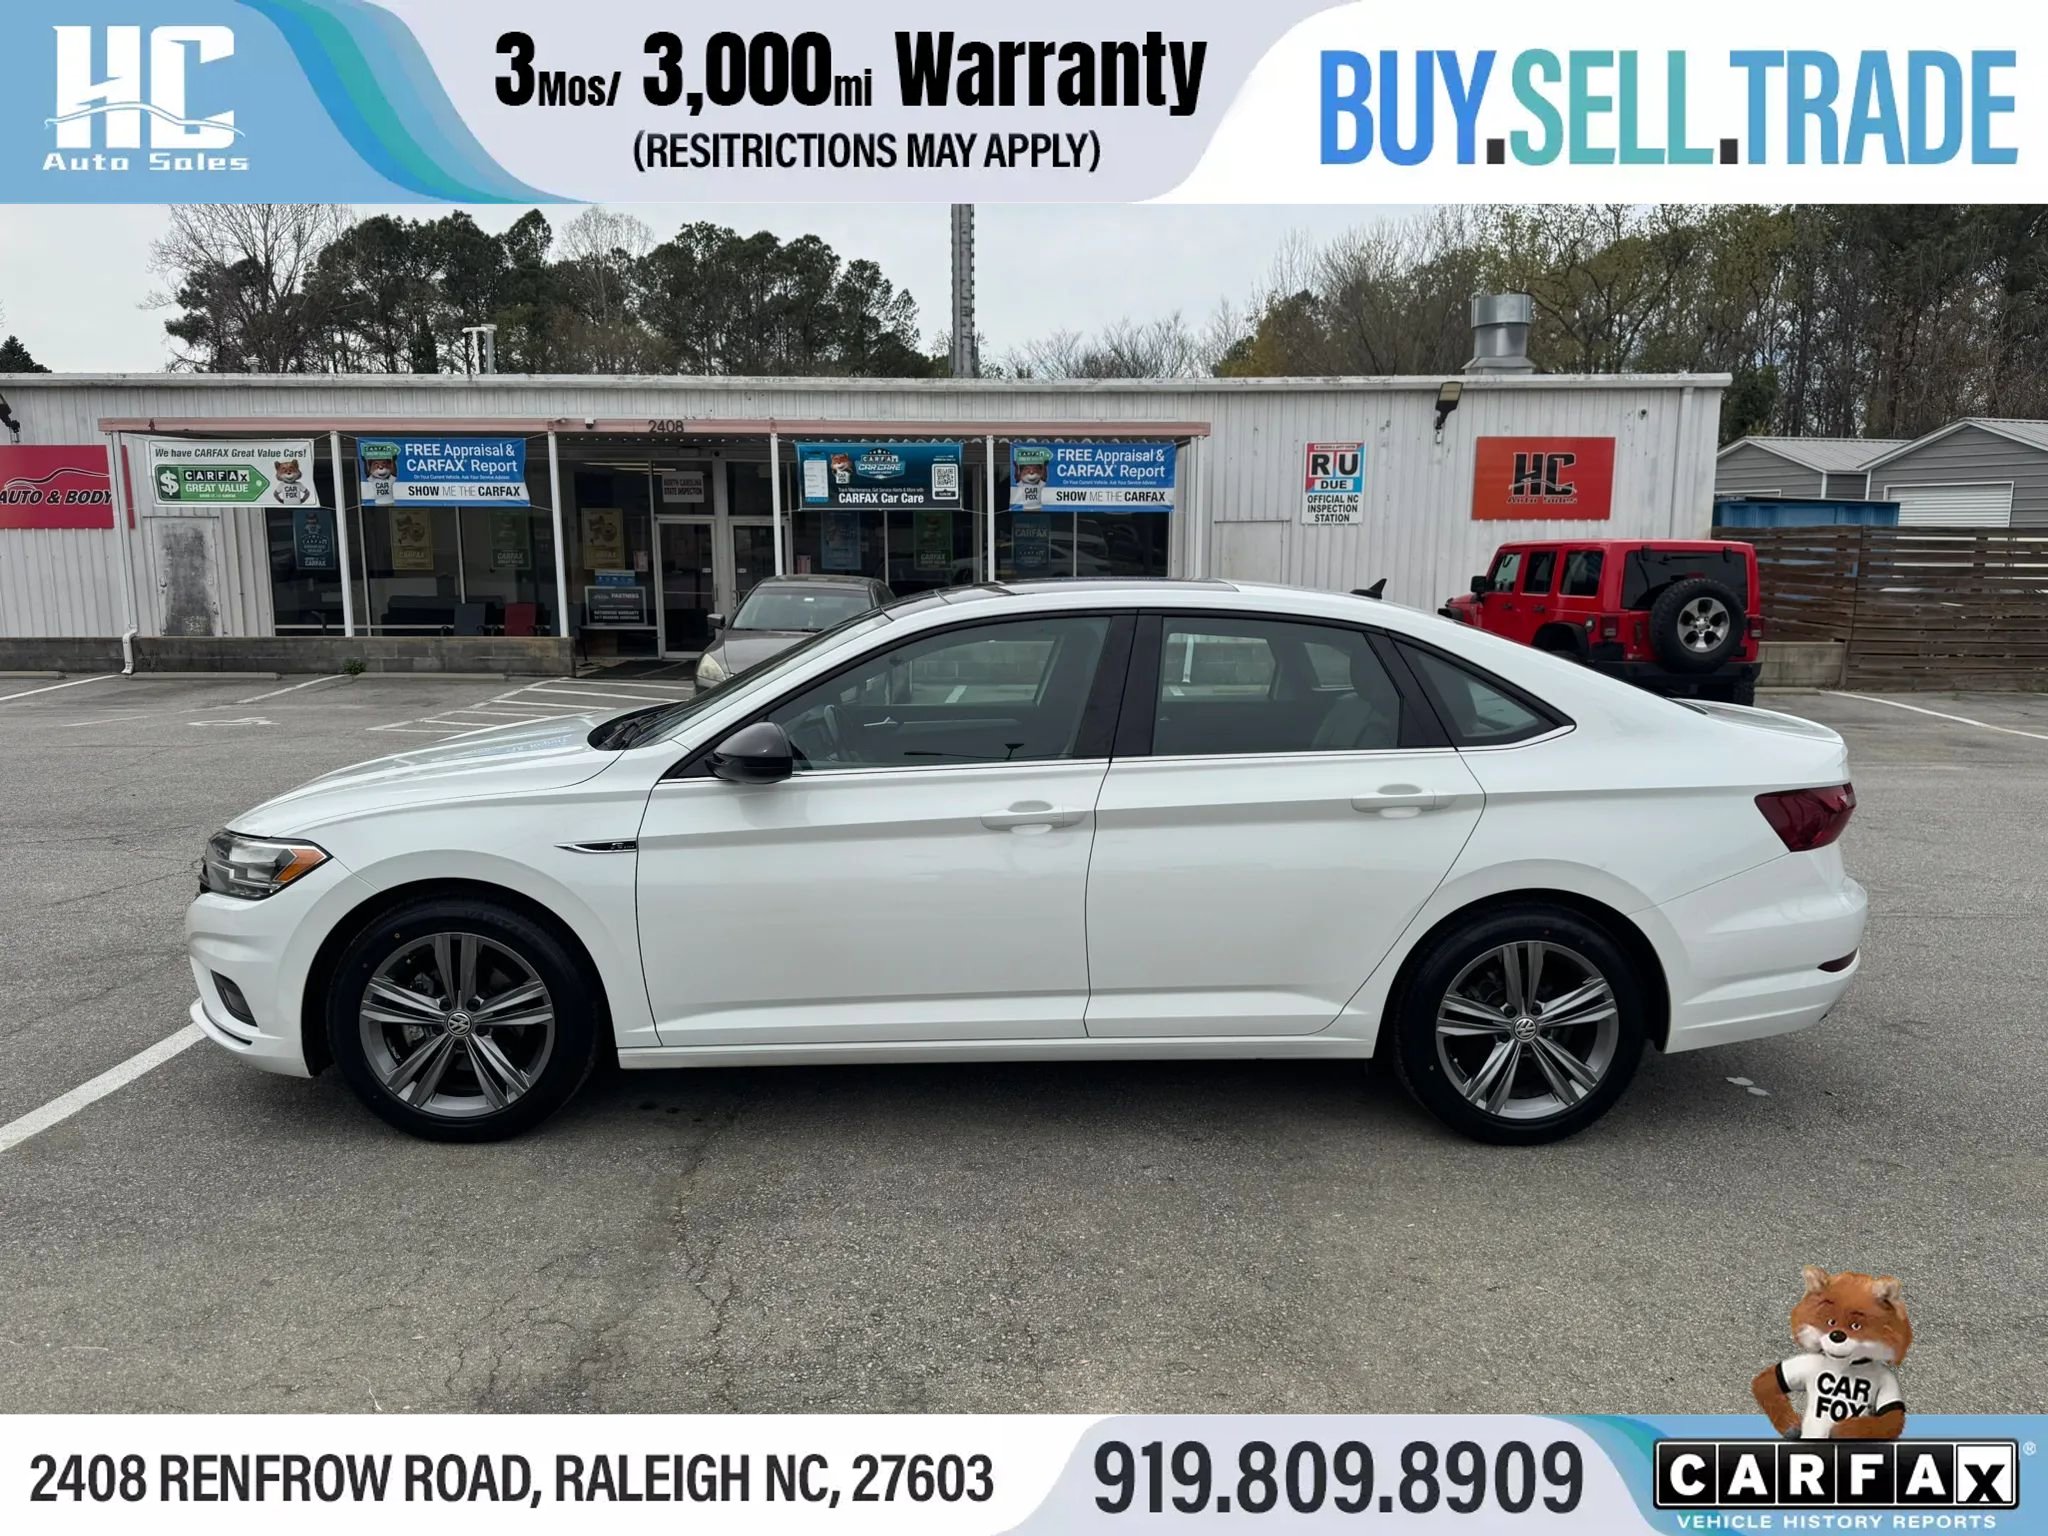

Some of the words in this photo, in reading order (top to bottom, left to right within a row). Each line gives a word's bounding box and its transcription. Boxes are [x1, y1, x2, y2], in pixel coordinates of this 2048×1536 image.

[648, 420, 685, 433] 2408
[155, 448, 168, 458] We
[171, 448, 192, 457] have
[194, 448, 229, 458] CARFAX
[231, 448, 255, 457] Great
[257, 448, 281, 457] Value
[283, 448, 306, 458] Cars!
[405, 443, 441, 456] FREE
[444, 443, 504, 459] Appraisal
[505, 443, 515, 456] &
[1057, 449, 1093, 462] FREE
[1094, 448, 1153, 465] Appraisal
[1155, 449, 1165, 462] &
[470, 459, 518, 474] Report
[1119, 464, 1166, 480] Report
[184, 471, 249, 482] CARFAX
[1512, 452, 1577, 497] HC
[185, 483, 216, 493] GREAT
[218, 483, 249, 493] VALUE
[1320, 480, 1347, 489] DUE
[0, 488, 43, 505] AUTO
[46, 488, 62, 505] &
[64, 488, 112, 505] BODY
[408, 485, 440, 497] SHOW
[442, 486, 456, 497] ME
[459, 486, 476, 497] THE
[478, 486, 521, 497] CARFAX
[1056, 490, 1087, 502] SHOW
[1089, 491, 1103, 502] ME
[1106, 491, 1122, 502] THE
[1124, 491, 1166, 502] CARFAX
[838, 492, 879, 504] CARFAX
[880, 492, 899, 504] Car
[900, 492, 925, 504] Care
[1307, 494, 1345, 503] OFFICIAL
[1347, 494, 1359, 503] NC
[1307, 504, 1358, 513] INSPECTION
[1314, 514, 1350, 523] STATION
